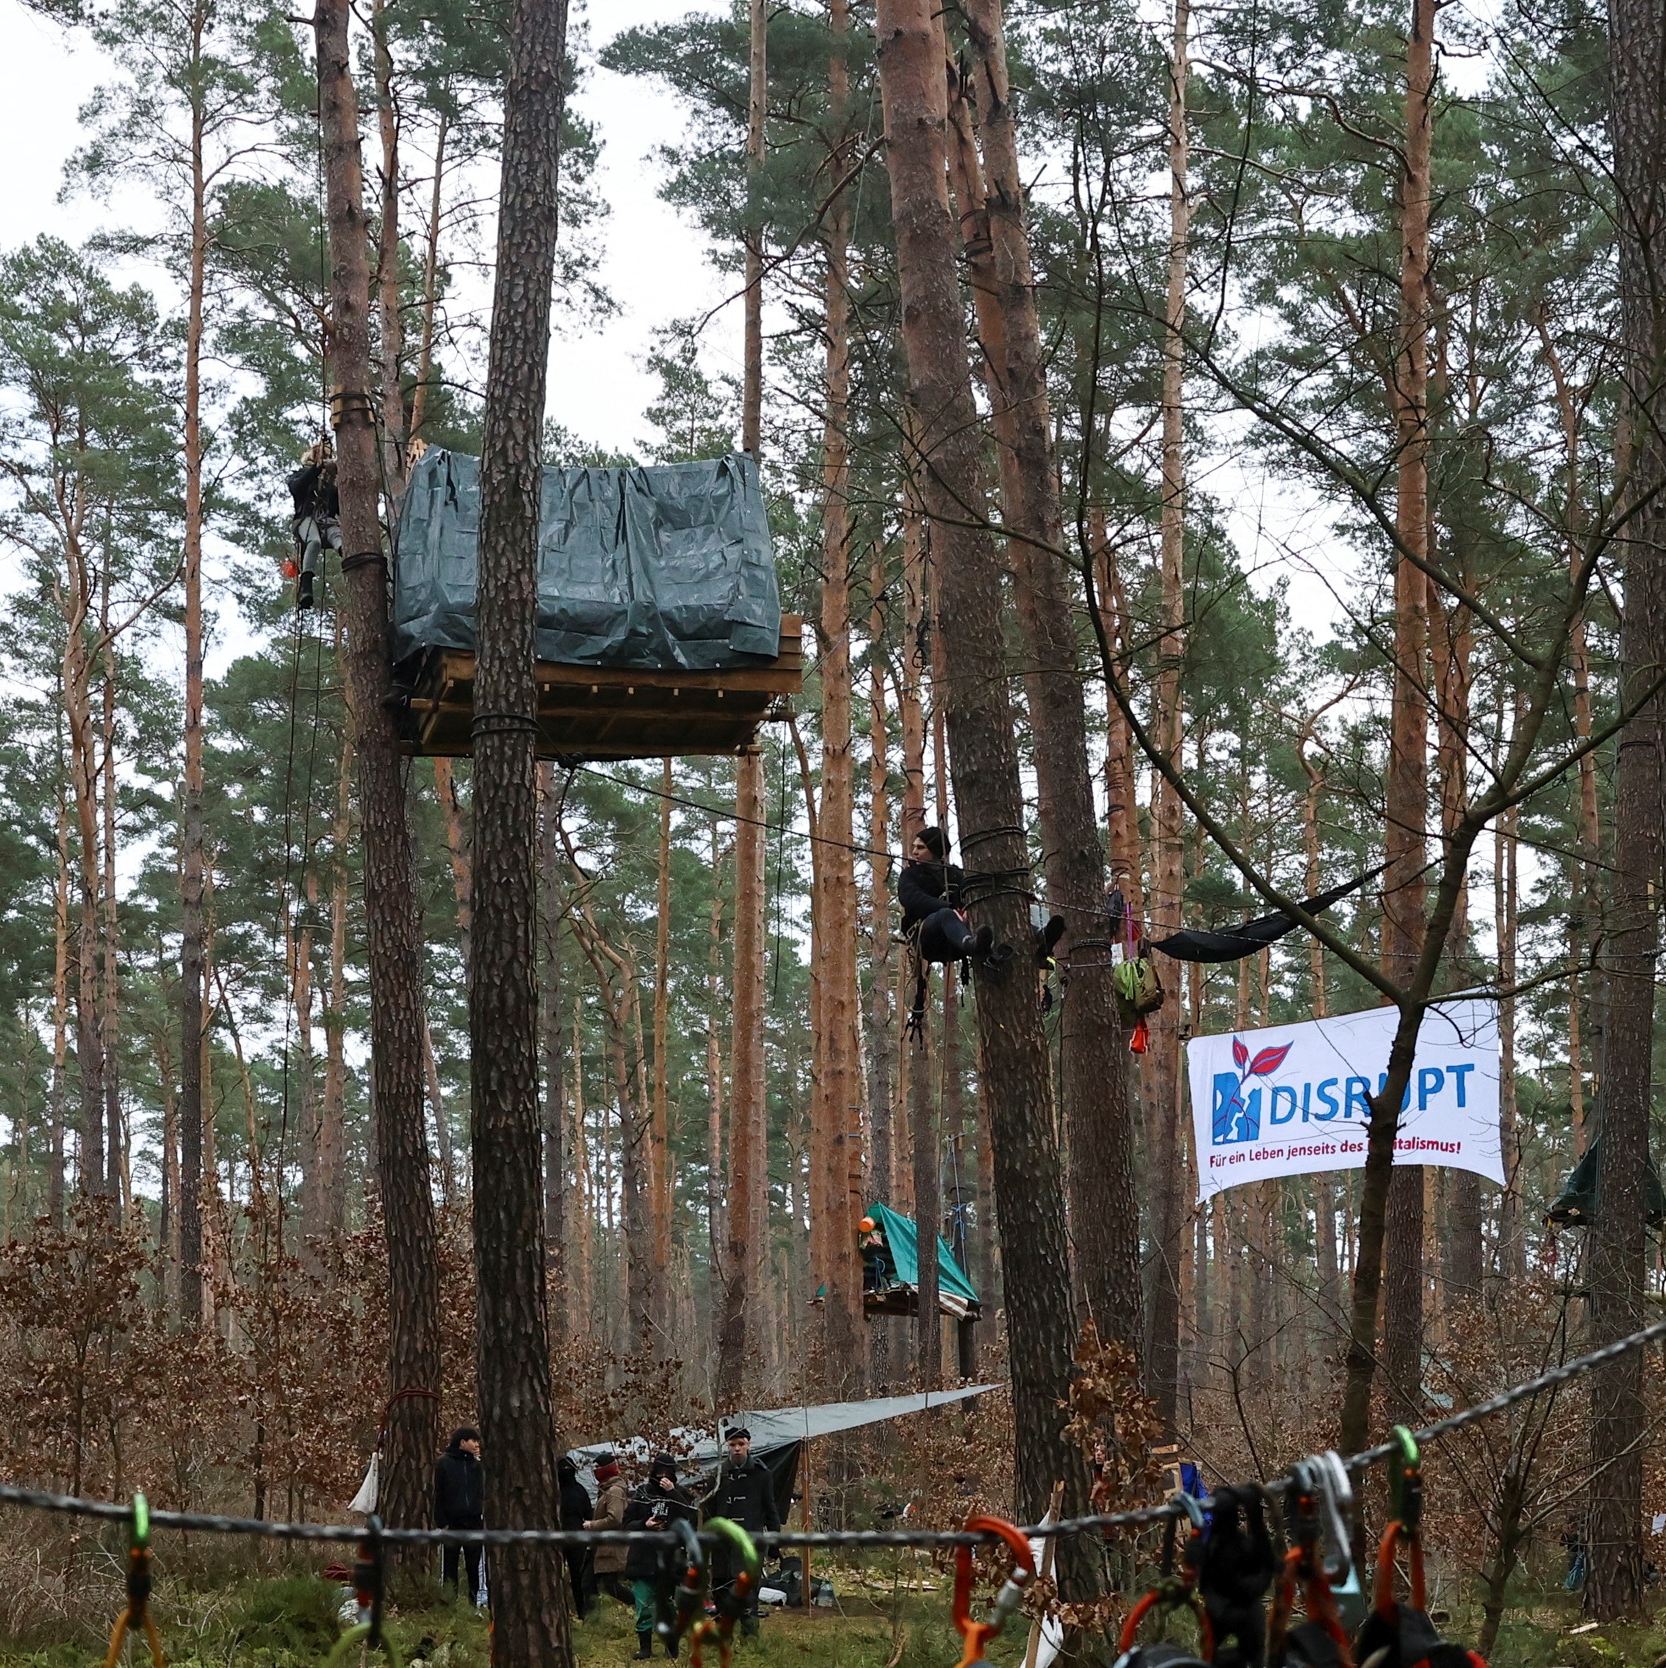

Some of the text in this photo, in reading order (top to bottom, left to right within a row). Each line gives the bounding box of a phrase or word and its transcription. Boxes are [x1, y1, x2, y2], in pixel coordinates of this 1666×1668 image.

[1209, 1137, 1461, 1168] Für ein Leben jenseits des italismus!
